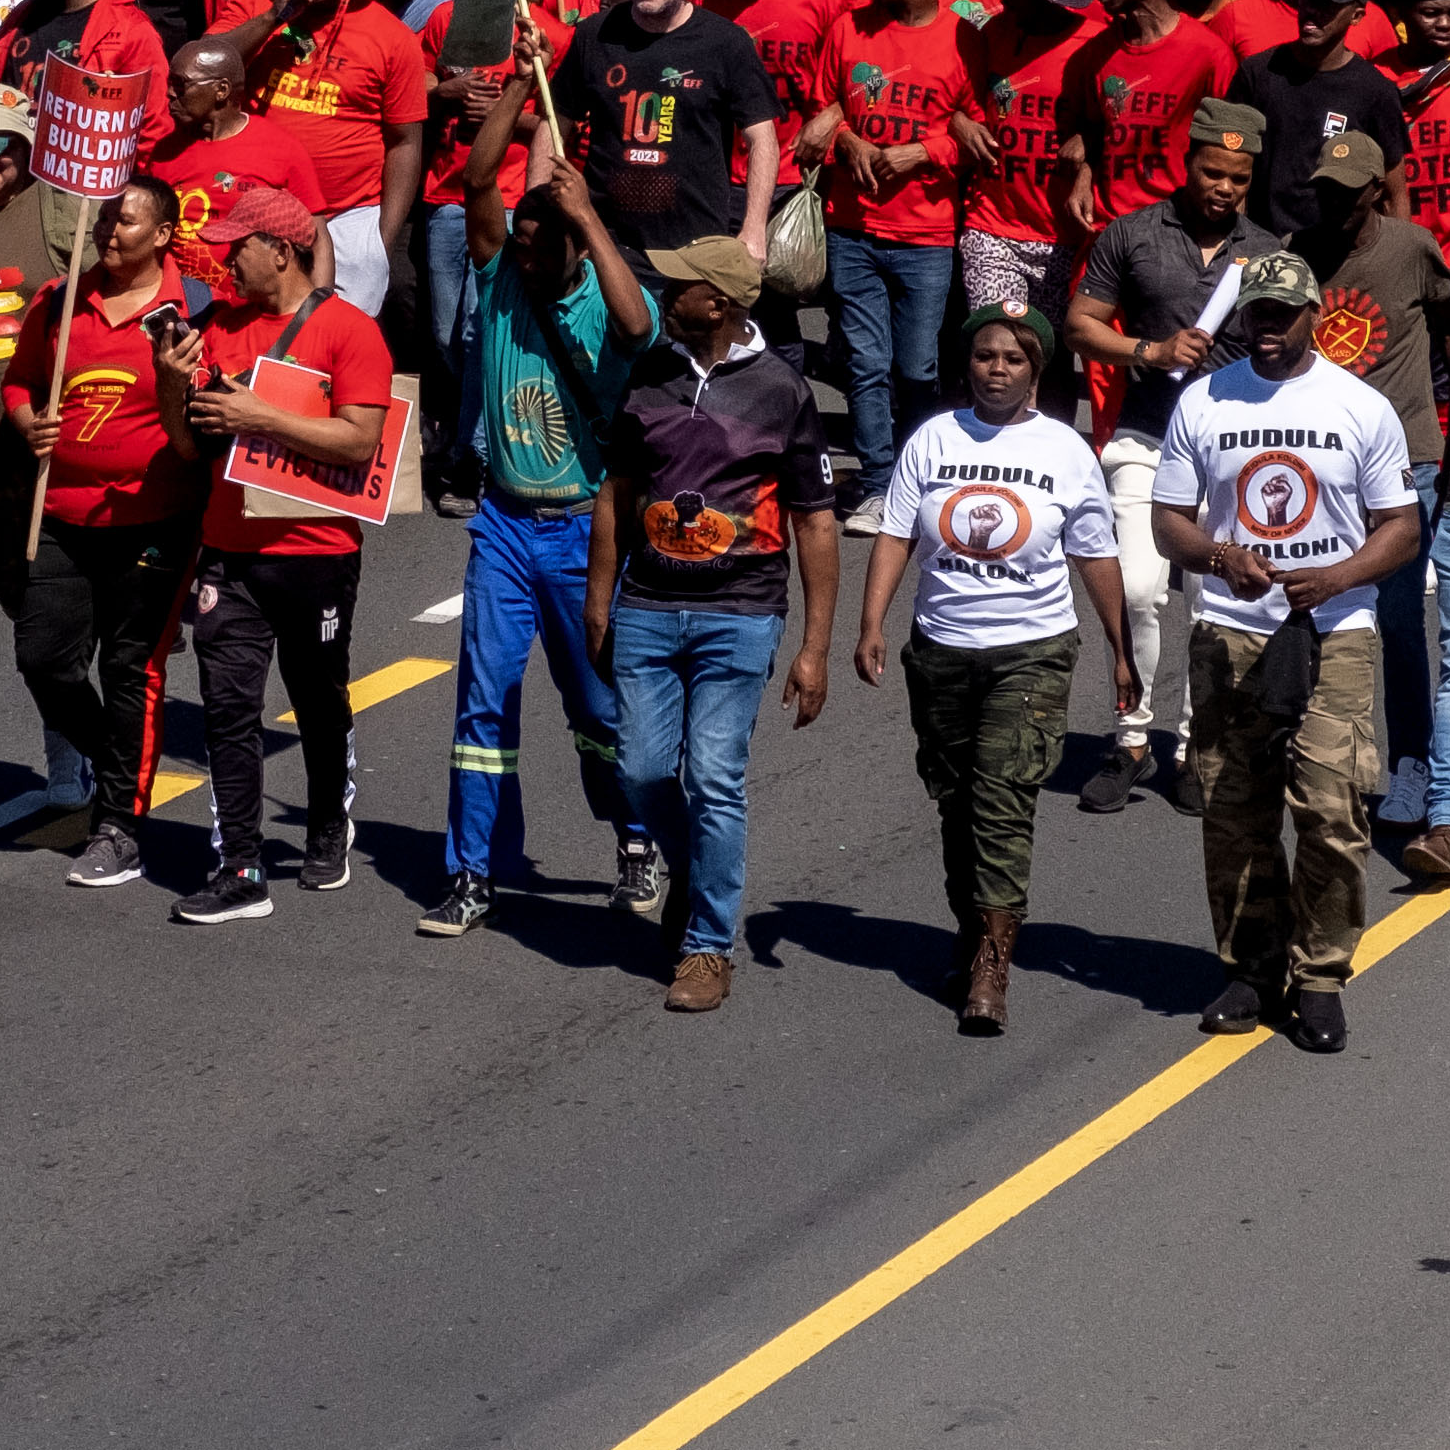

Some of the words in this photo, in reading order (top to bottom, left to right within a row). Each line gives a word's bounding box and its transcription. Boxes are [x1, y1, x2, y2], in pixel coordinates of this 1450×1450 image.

[762, 40, 809, 64] EFF
[101, 86, 123, 99] EFF
[683, 78, 704, 91] EFF
[891, 81, 938, 109] EFF
[44, 85, 125, 133] RETURN
[619, 89, 661, 144] 10
[1132, 91, 1178, 116] EFF
[656, 95, 677, 144] YEARS
[851, 113, 930, 145] VOTE
[47, 121, 137, 161] BUILDING
[629, 149, 660, 163] 2023
[76, 394, 122, 443] 7
[1218, 430, 1344, 453] DUDULA
[820, 453, 834, 485] 9
[938, 464, 1056, 495] DUDULA
